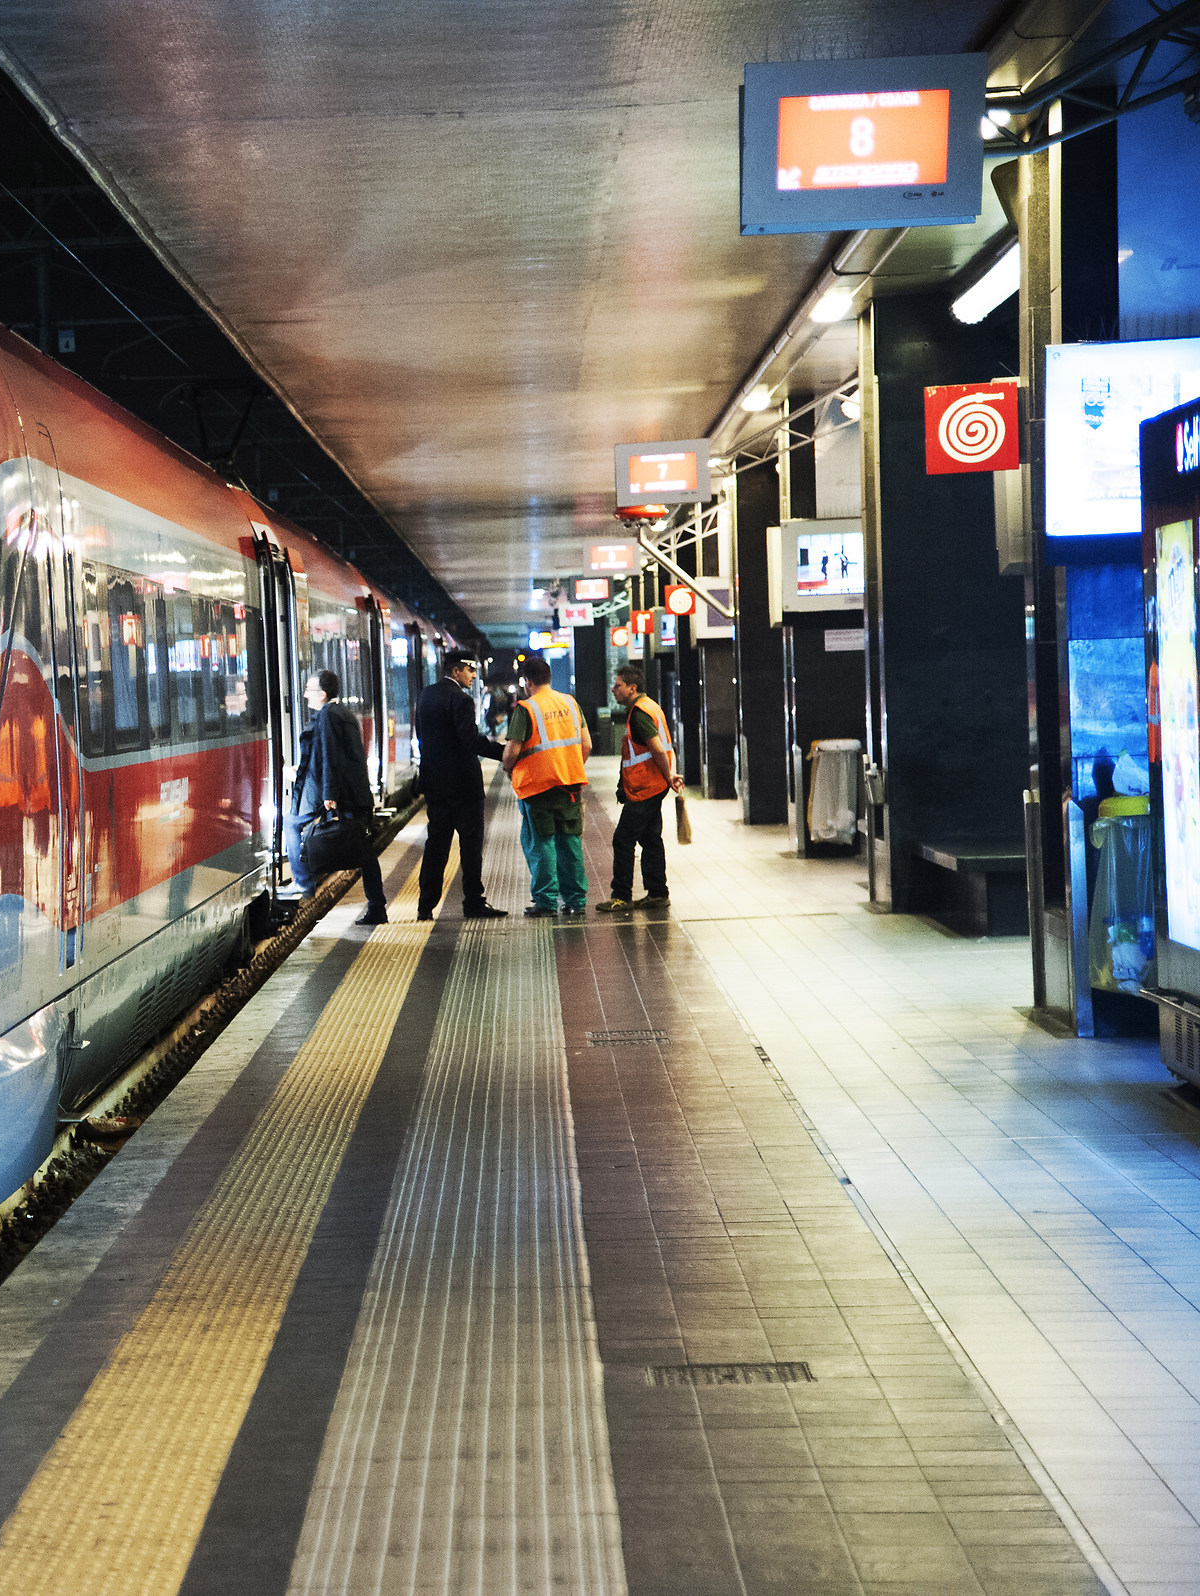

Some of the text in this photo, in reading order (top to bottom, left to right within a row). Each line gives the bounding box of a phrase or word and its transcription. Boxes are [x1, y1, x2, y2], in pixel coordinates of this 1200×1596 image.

[850, 116, 875, 157] 8
[657, 463, 668, 480] 7
[544, 708, 569, 720] SITAV
